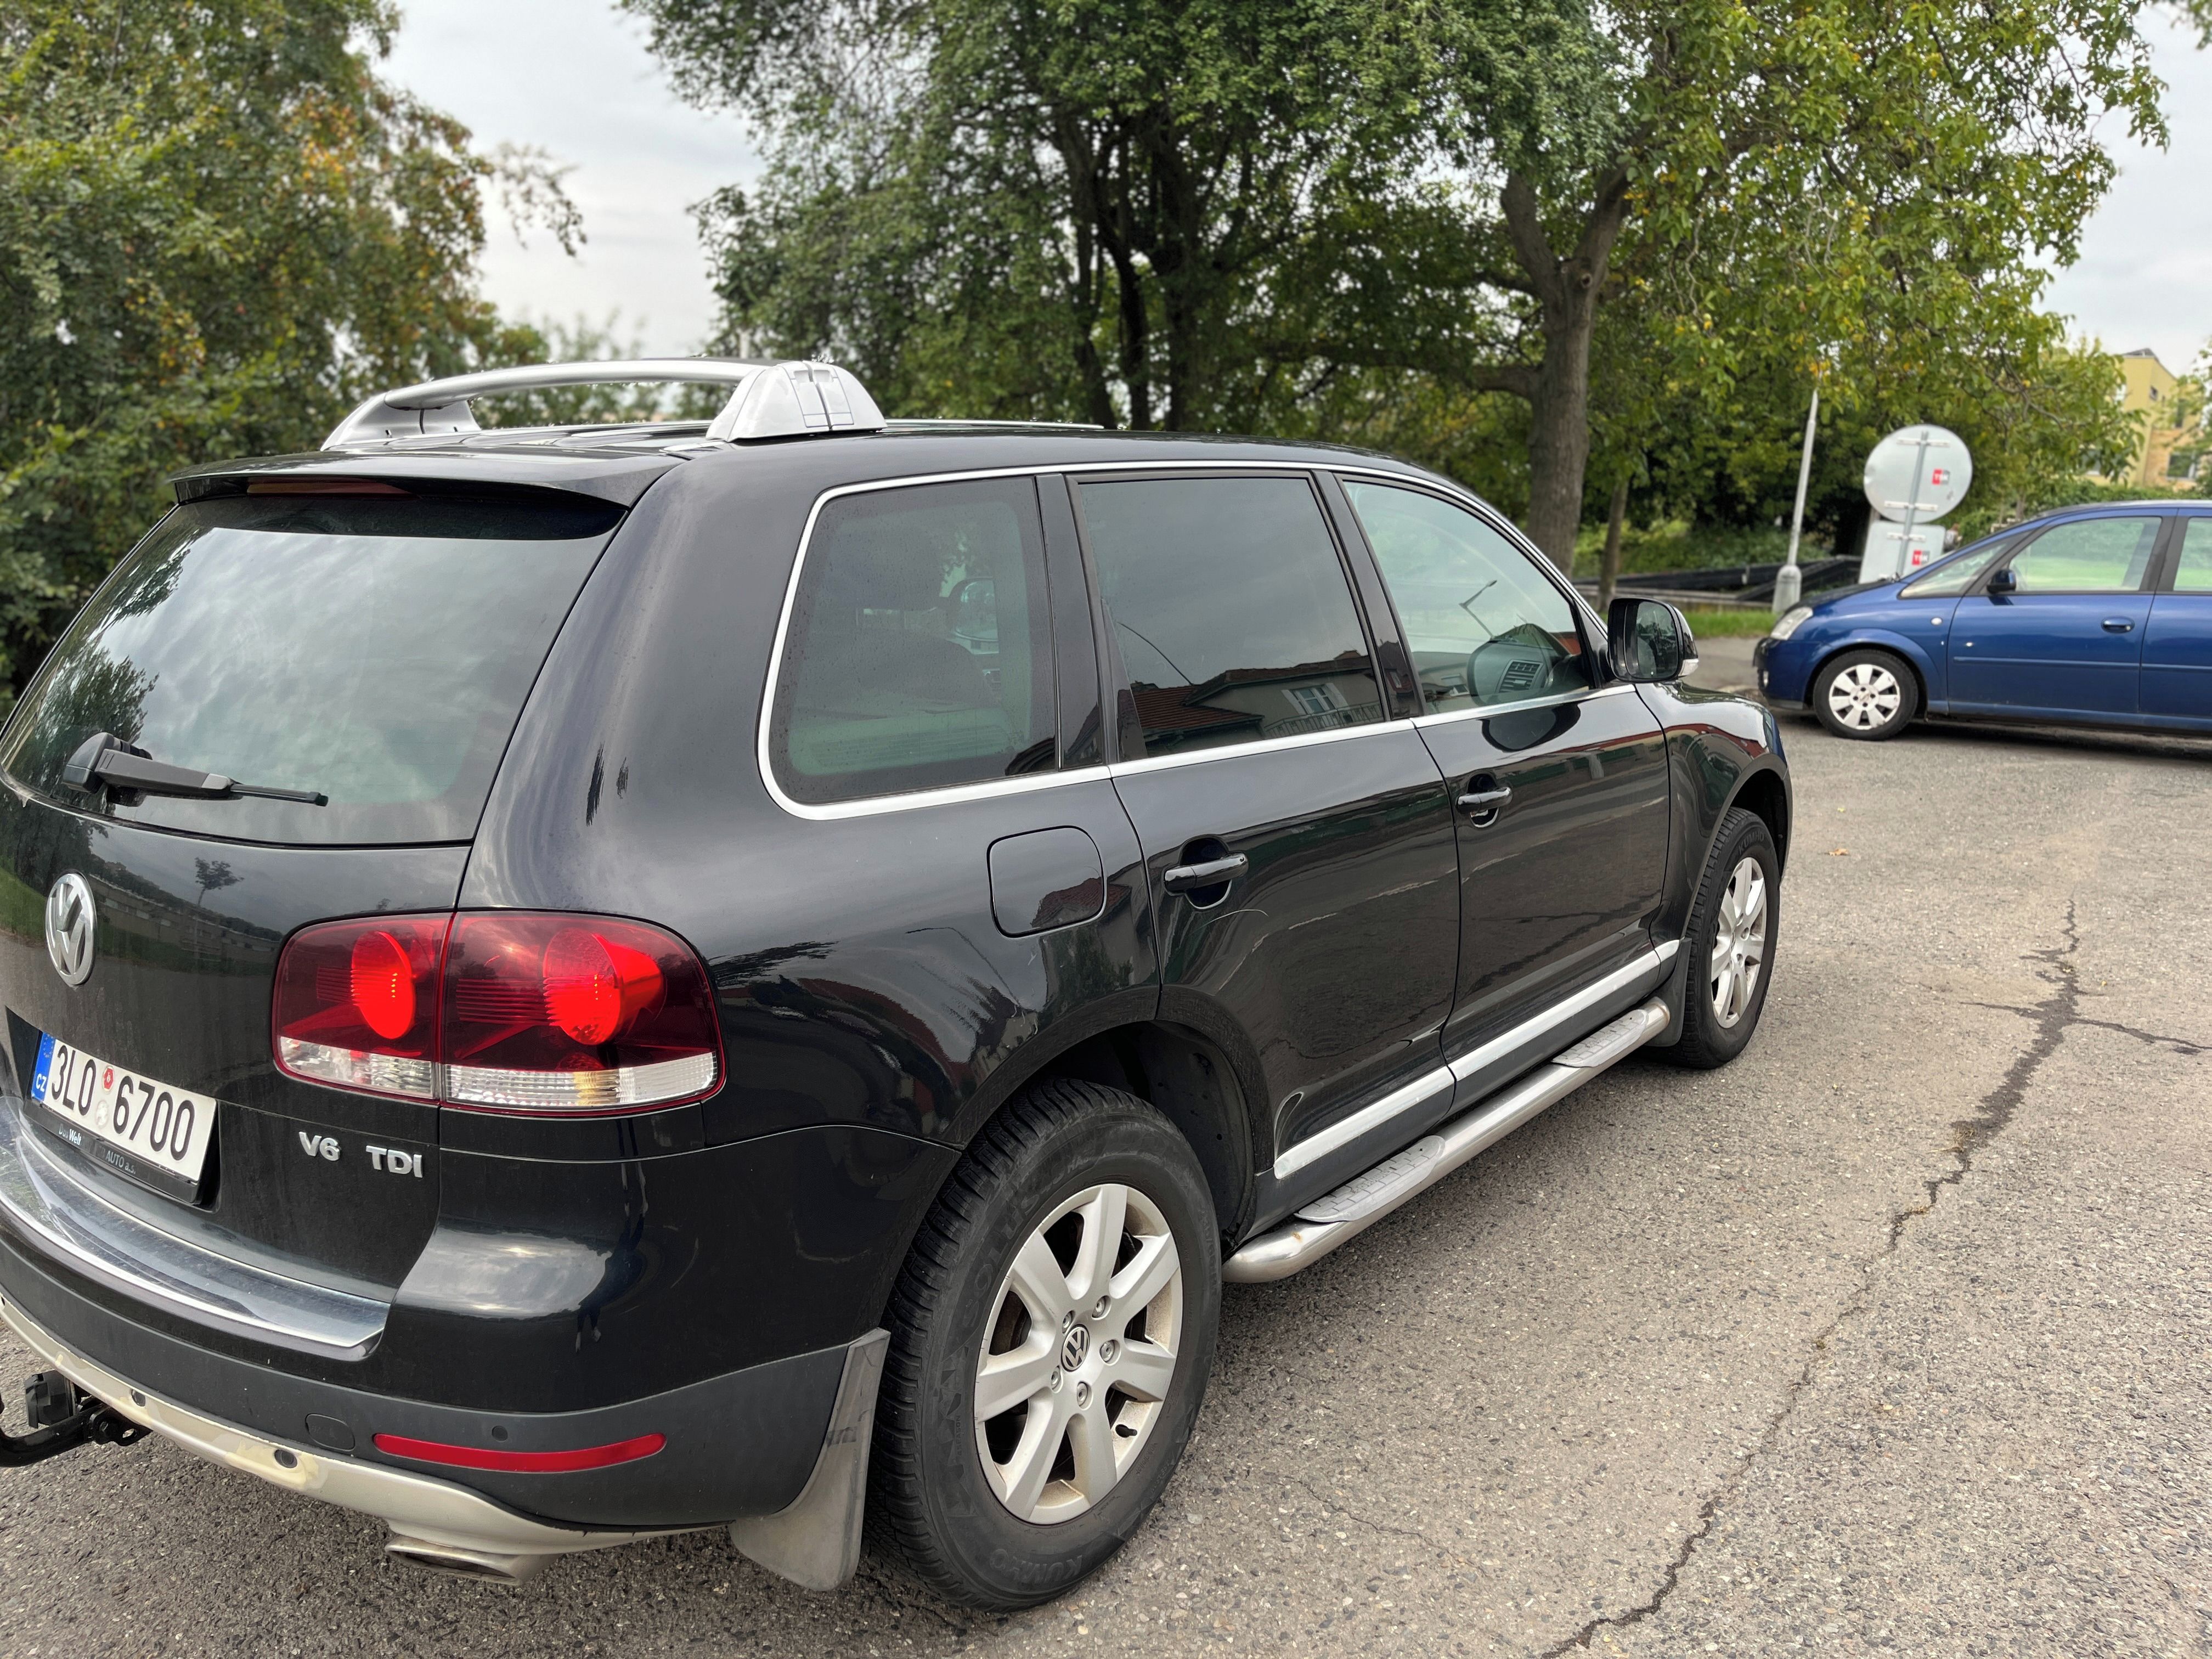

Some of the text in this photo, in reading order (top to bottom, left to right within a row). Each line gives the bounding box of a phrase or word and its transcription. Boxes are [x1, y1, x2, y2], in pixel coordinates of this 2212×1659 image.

[1739, 828, 1764, 855] KUMHO
[36, 1074, 47, 1092] CZ
[113, 1075, 195, 1161] 6700
[105, 1150, 125, 1168] AUTO
[298, 1131, 424, 1178] V6 TDI
